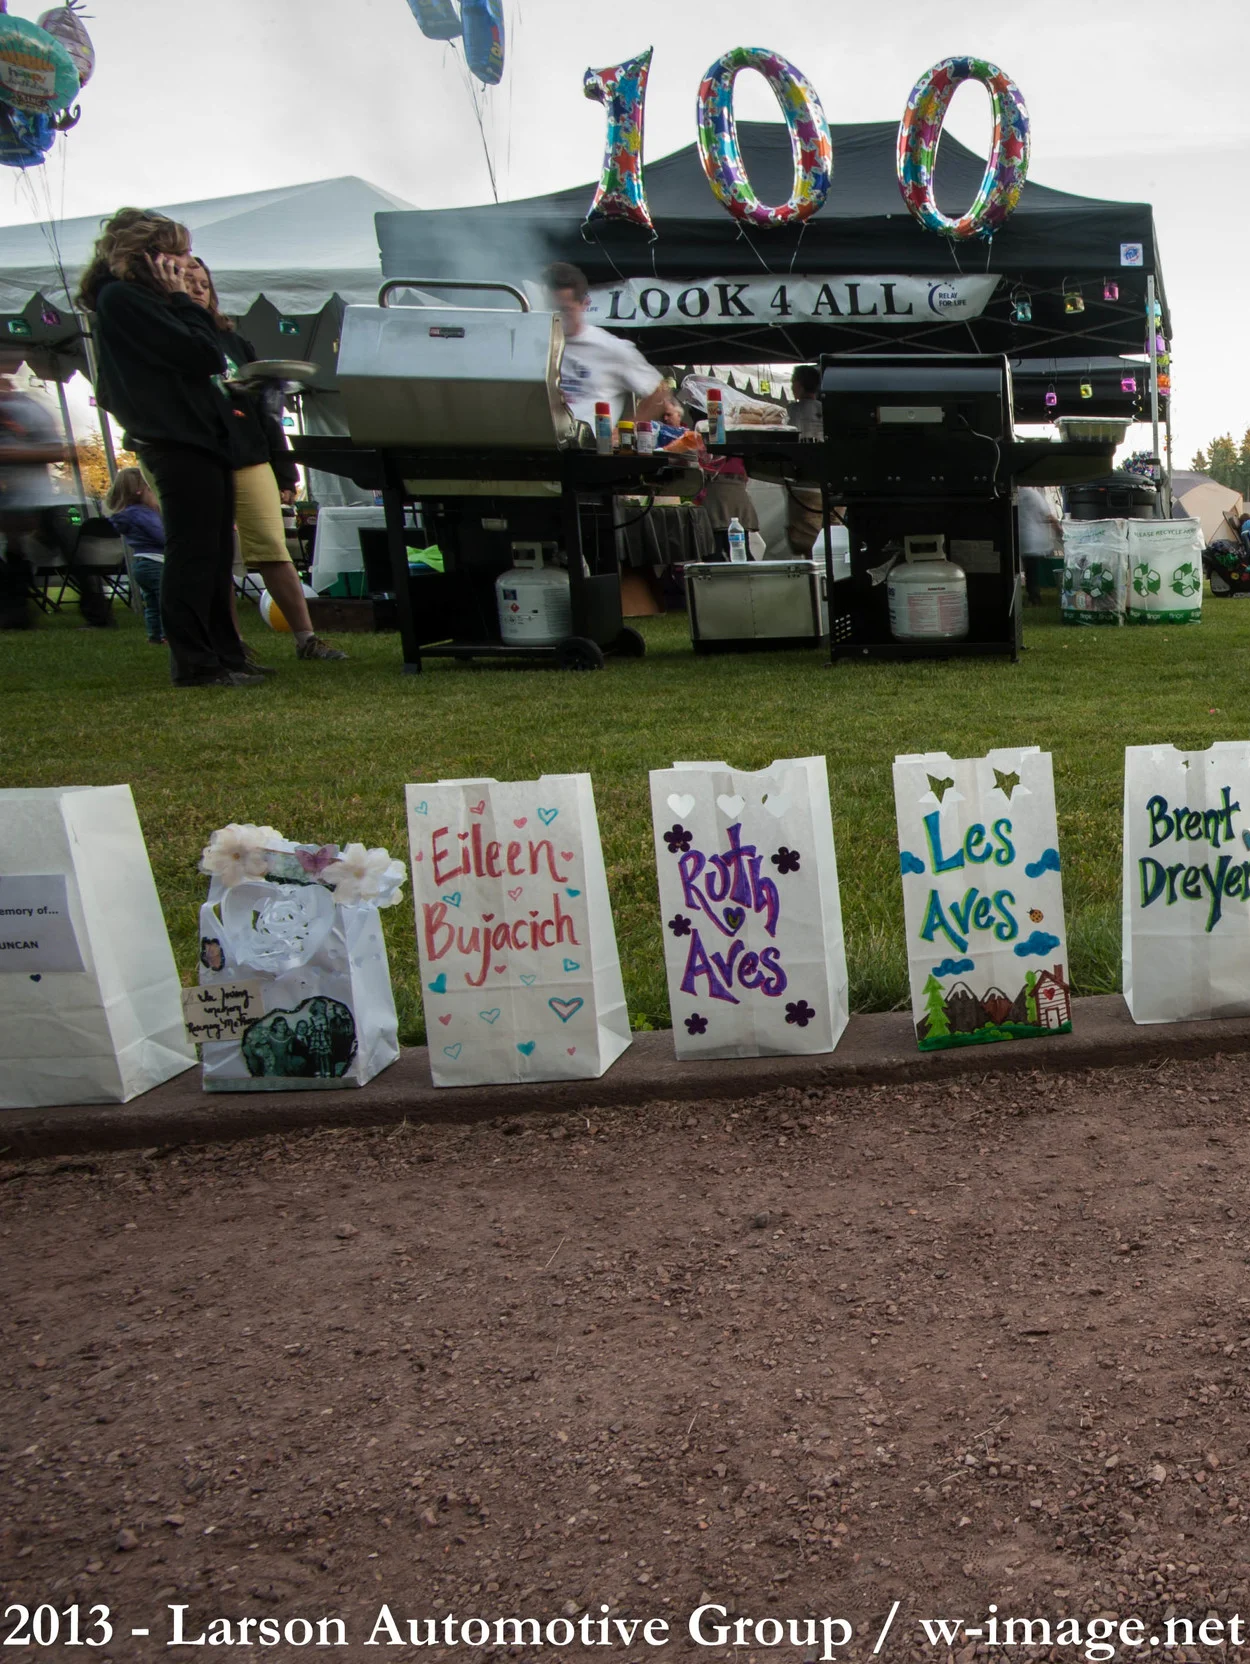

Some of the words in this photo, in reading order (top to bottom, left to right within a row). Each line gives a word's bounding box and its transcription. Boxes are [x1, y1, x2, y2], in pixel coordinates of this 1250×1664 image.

[606, 284, 755, 321] LOOK
[770, 284, 793, 316] 4
[811, 283, 914, 317] ALL
[938, 291, 958, 299] RELAY
[924, 810, 1017, 876] Les
[1146, 786, 1242, 849] Brent
[431, 823, 569, 887] Eileen
[678, 822, 781, 939] Ruth
[0, 907, 34, 918] emory
[422, 892, 581, 988] Bujacich
[919, 887, 1021, 955] Aves
[0, 940, 40, 951] UNCAN
[680, 928, 788, 1005] Aves
